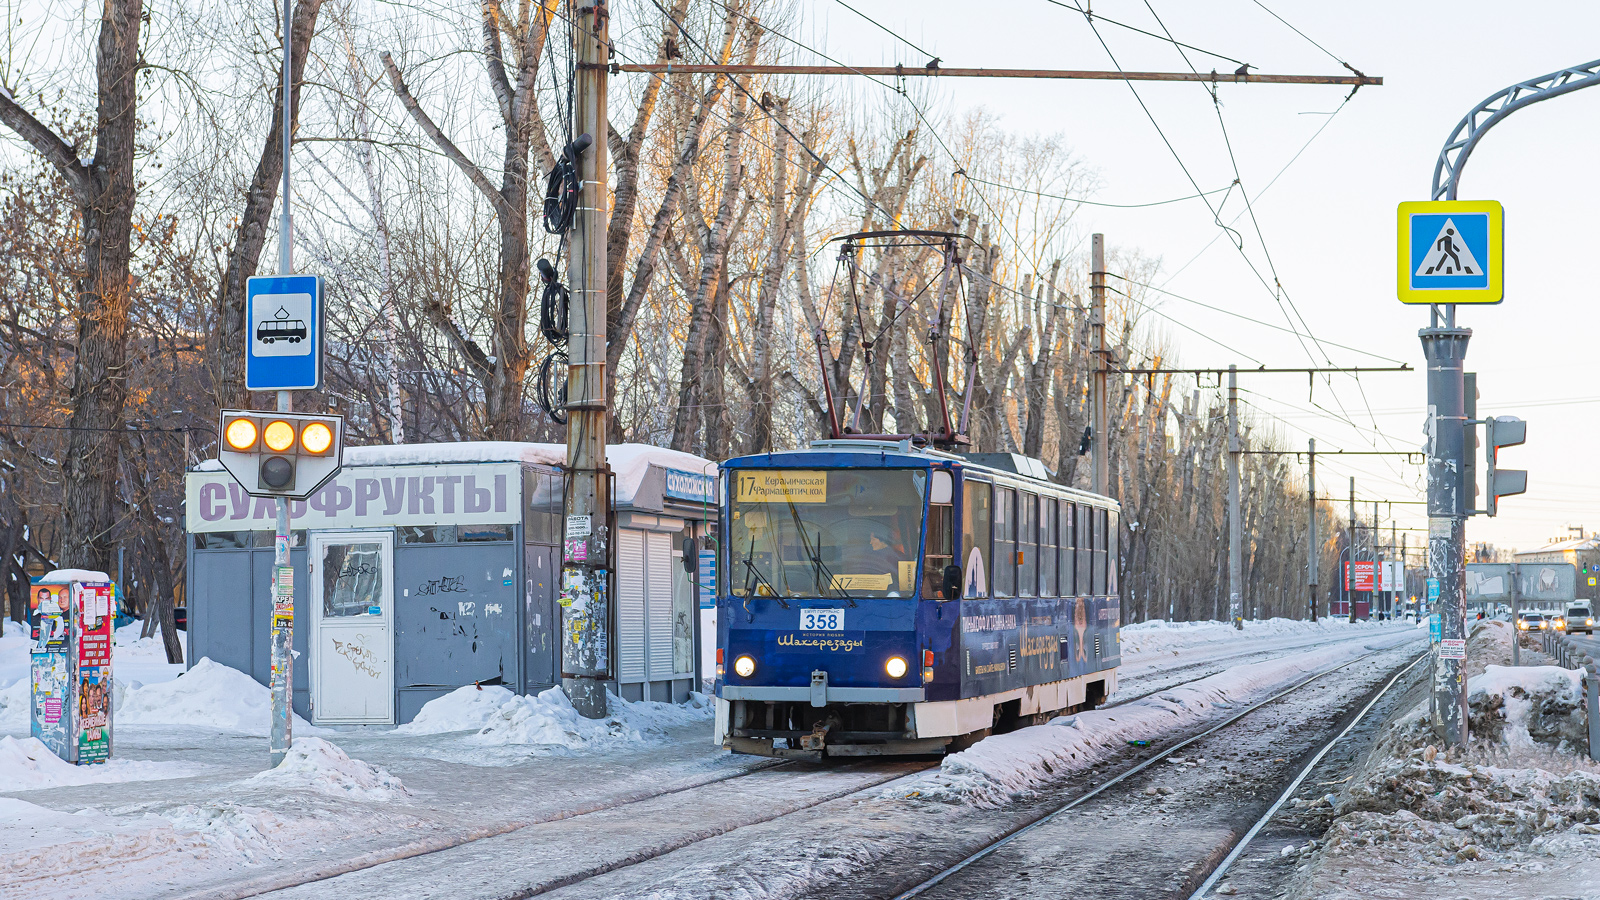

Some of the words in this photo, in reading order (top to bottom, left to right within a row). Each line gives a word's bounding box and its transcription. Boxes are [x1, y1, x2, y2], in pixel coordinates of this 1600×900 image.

[740, 476, 756, 496] 17
[765, 476, 825, 487] Керамическая
[839, 577, 853, 589] 17
[805, 614, 838, 630] 358
[777, 633, 863, 652] Шахерезады
